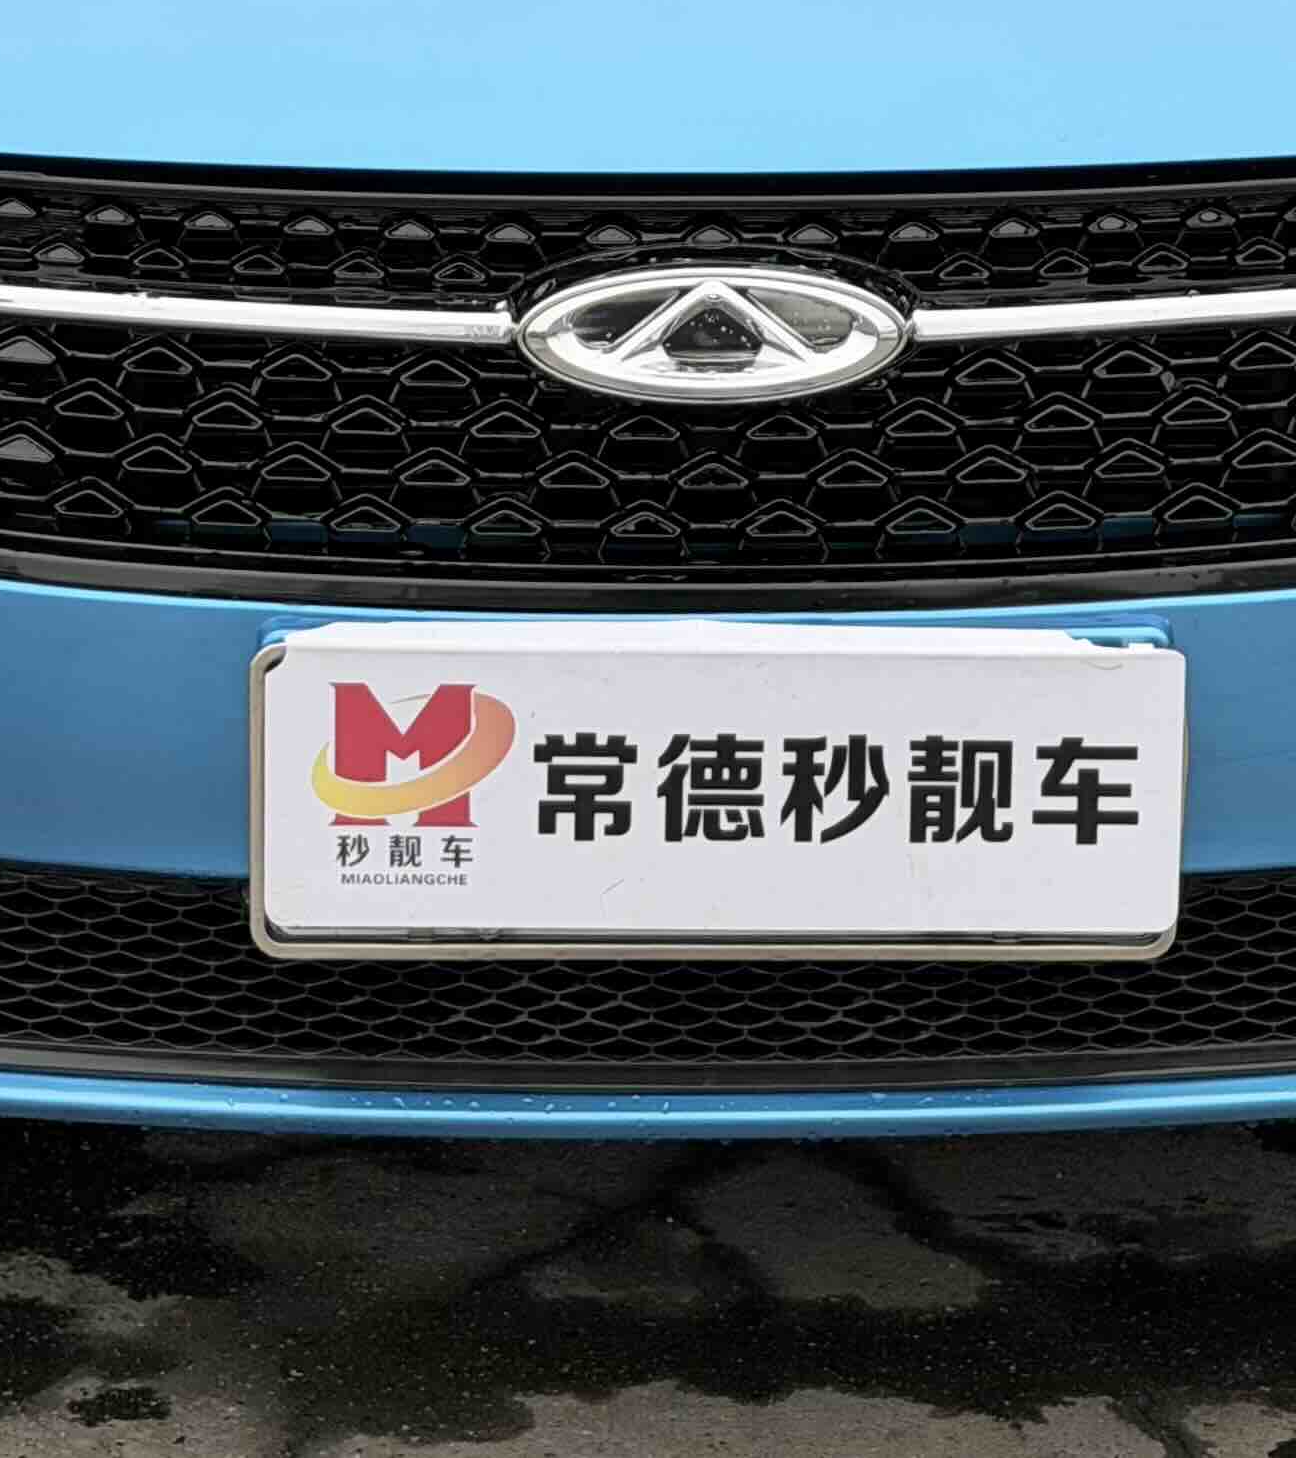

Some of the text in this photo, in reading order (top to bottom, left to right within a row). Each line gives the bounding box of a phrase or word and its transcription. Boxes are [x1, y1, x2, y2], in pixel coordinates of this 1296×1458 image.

[533, 732, 1139, 844] 常德秒靓车
[335, 833, 474, 868] 秒靓车
[340, 873, 468, 886] MIAOLIANGCHE
